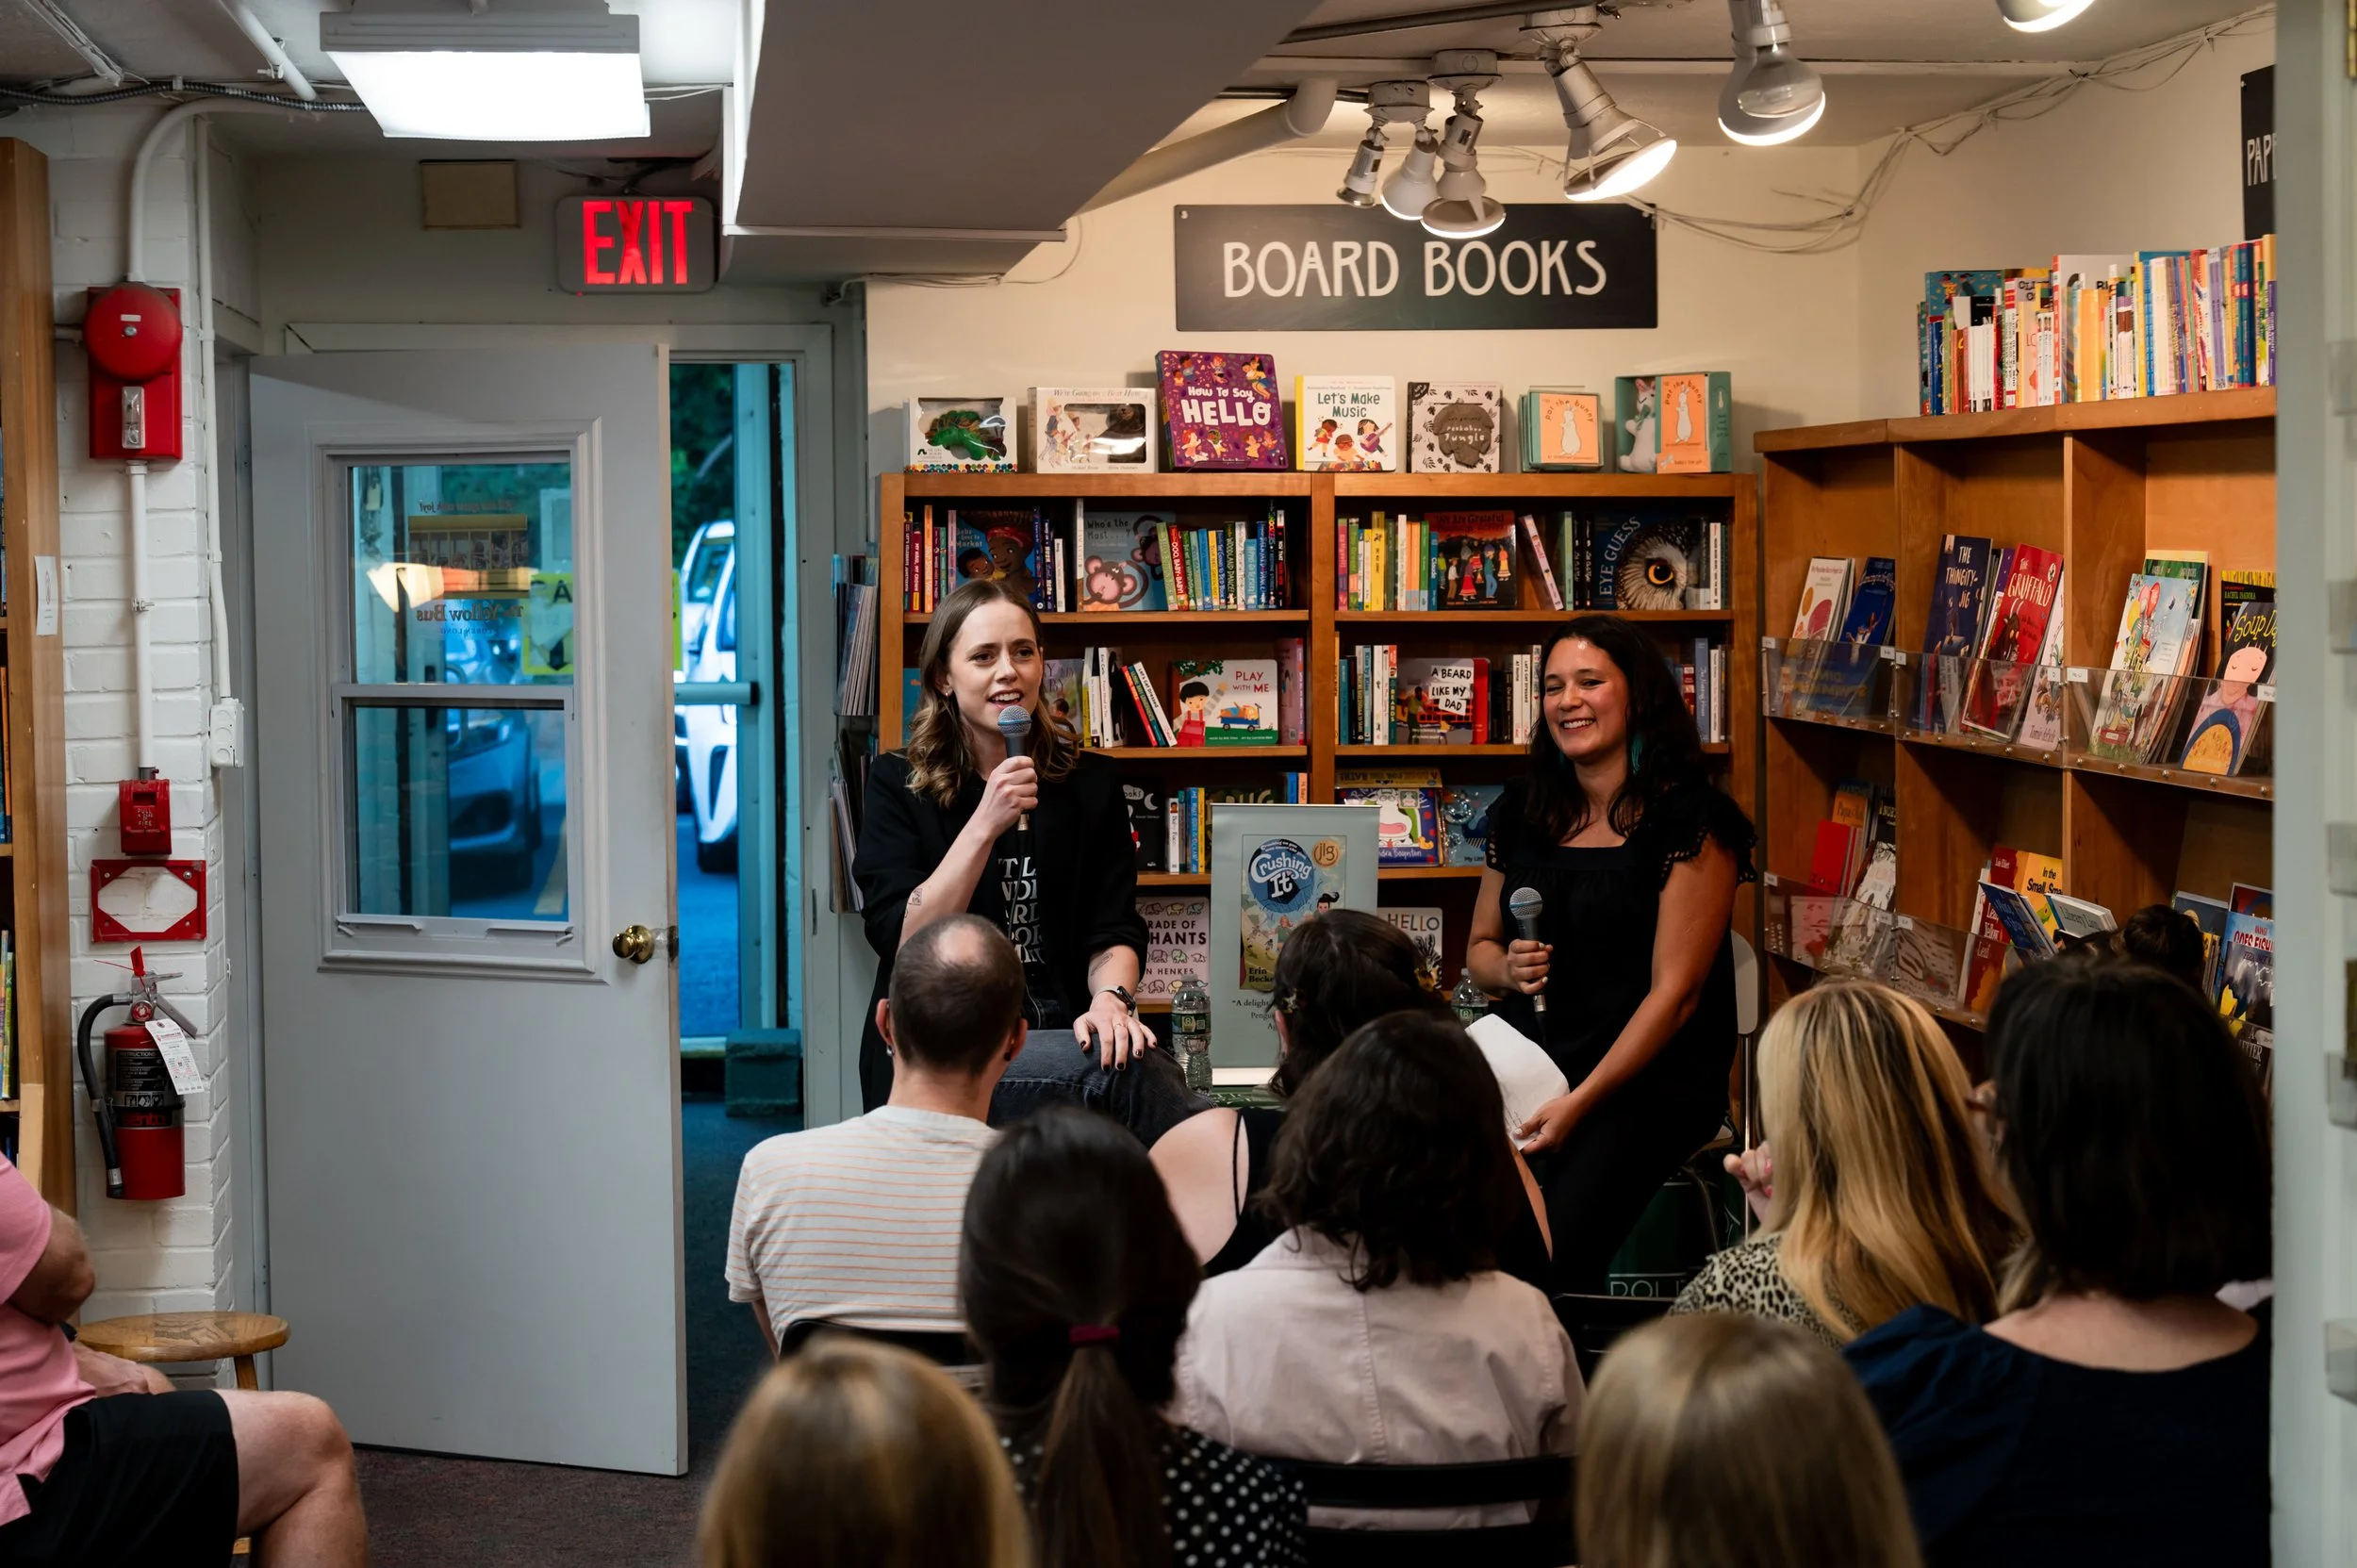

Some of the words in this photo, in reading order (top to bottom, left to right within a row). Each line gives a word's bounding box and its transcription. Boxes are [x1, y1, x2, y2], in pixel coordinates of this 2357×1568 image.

[583, 200, 694, 285] EXIT
[1224, 240, 1399, 298] BOARD
[1425, 239, 1607, 297] BOOKS
[1188, 386, 1213, 396] How
[1216, 387, 1229, 396] To
[1232, 388, 1255, 404] Say
[1317, 392, 1346, 404] Let's
[1350, 391, 1380, 404] Make
[1180, 398, 1272, 426] HELLO
[1544, 406, 1555, 421] pat
[1574, 399, 1594, 423] bunny
[1444, 433, 1485, 444] Jungle
[1087, 520, 1112, 529] Who's
[1114, 519, 1129, 528] the
[1604, 516, 1641, 561] GUESS
[1958, 546, 1972, 564] THE
[1599, 564, 1614, 596] EYE
[2007, 572, 2052, 607] GRUFFALO
[1235, 670, 1263, 682] PLAY
[1431, 668, 1439, 677] A
[1441, 668, 1472, 680] BEARD
[1138, 668, 1146, 680] Let's
[1147, 688, 1159, 708] Dressed
[1253, 684, 1270, 693] ME
[1431, 686, 1450, 697] LIKE
[1453, 686, 1466, 697] MY
[1444, 699, 1462, 711] DAD
[1124, 789, 1142, 798] ooks
[1318, 843, 1336, 861] jlg
[1393, 850, 1422, 858] Boynton
[1250, 851, 1312, 883] Crushing
[2042, 867, 2048, 877] In
[2048, 868, 2056, 880] the
[1271, 871, 1294, 898] It
[2049, 883, 2063, 895] Sma
[1147, 920, 1178, 930] RADE
[1181, 920, 1196, 930] OF
[1387, 913, 1440, 932] HELLO
[1149, 932, 1207, 945] HANTS
[1158, 967, 1195, 976] HENKES
[1251, 1012, 1274, 1020] Pengu
